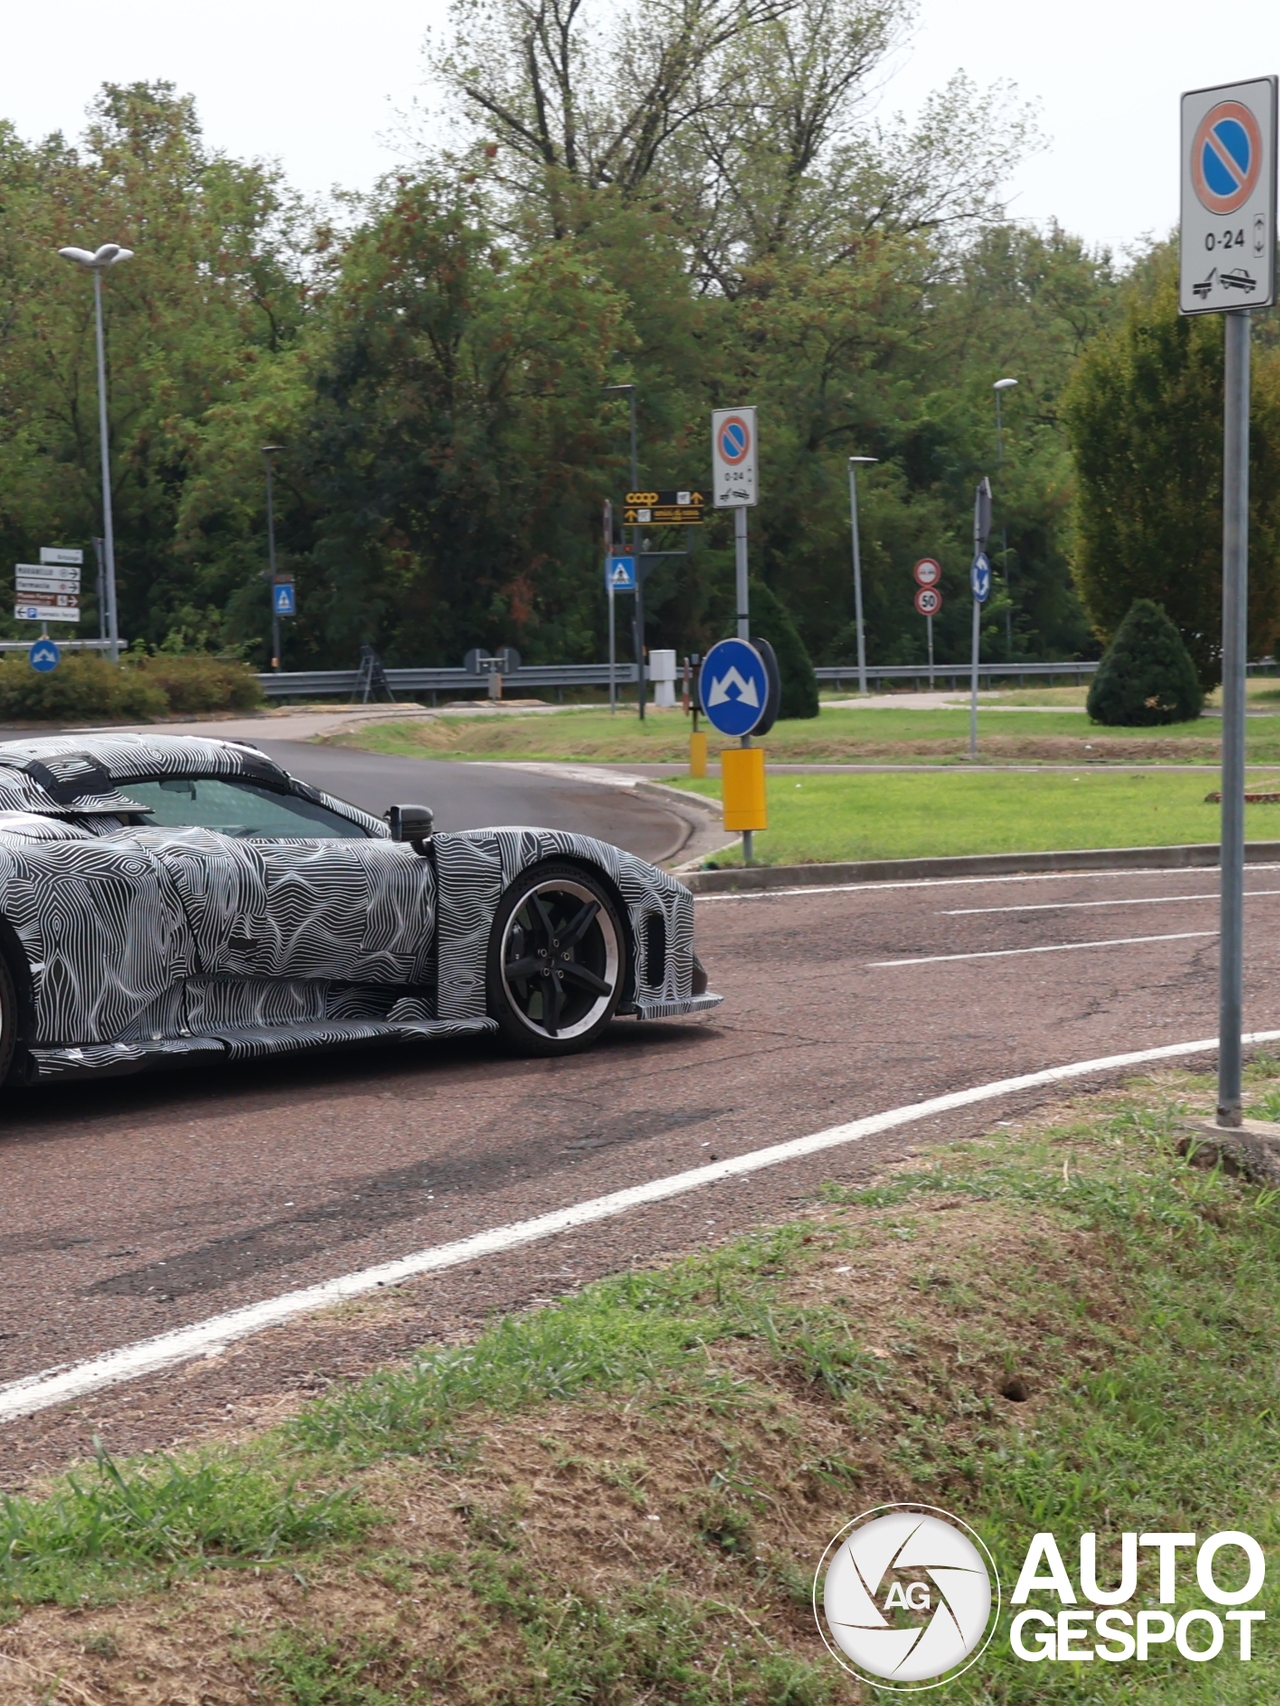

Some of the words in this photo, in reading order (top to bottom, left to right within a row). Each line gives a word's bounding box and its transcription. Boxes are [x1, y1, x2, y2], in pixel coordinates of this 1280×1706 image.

[1205, 229, 1244, 251] 0-24
[724, 471, 744, 481] 0-24
[922, 595, 935, 608] 50
